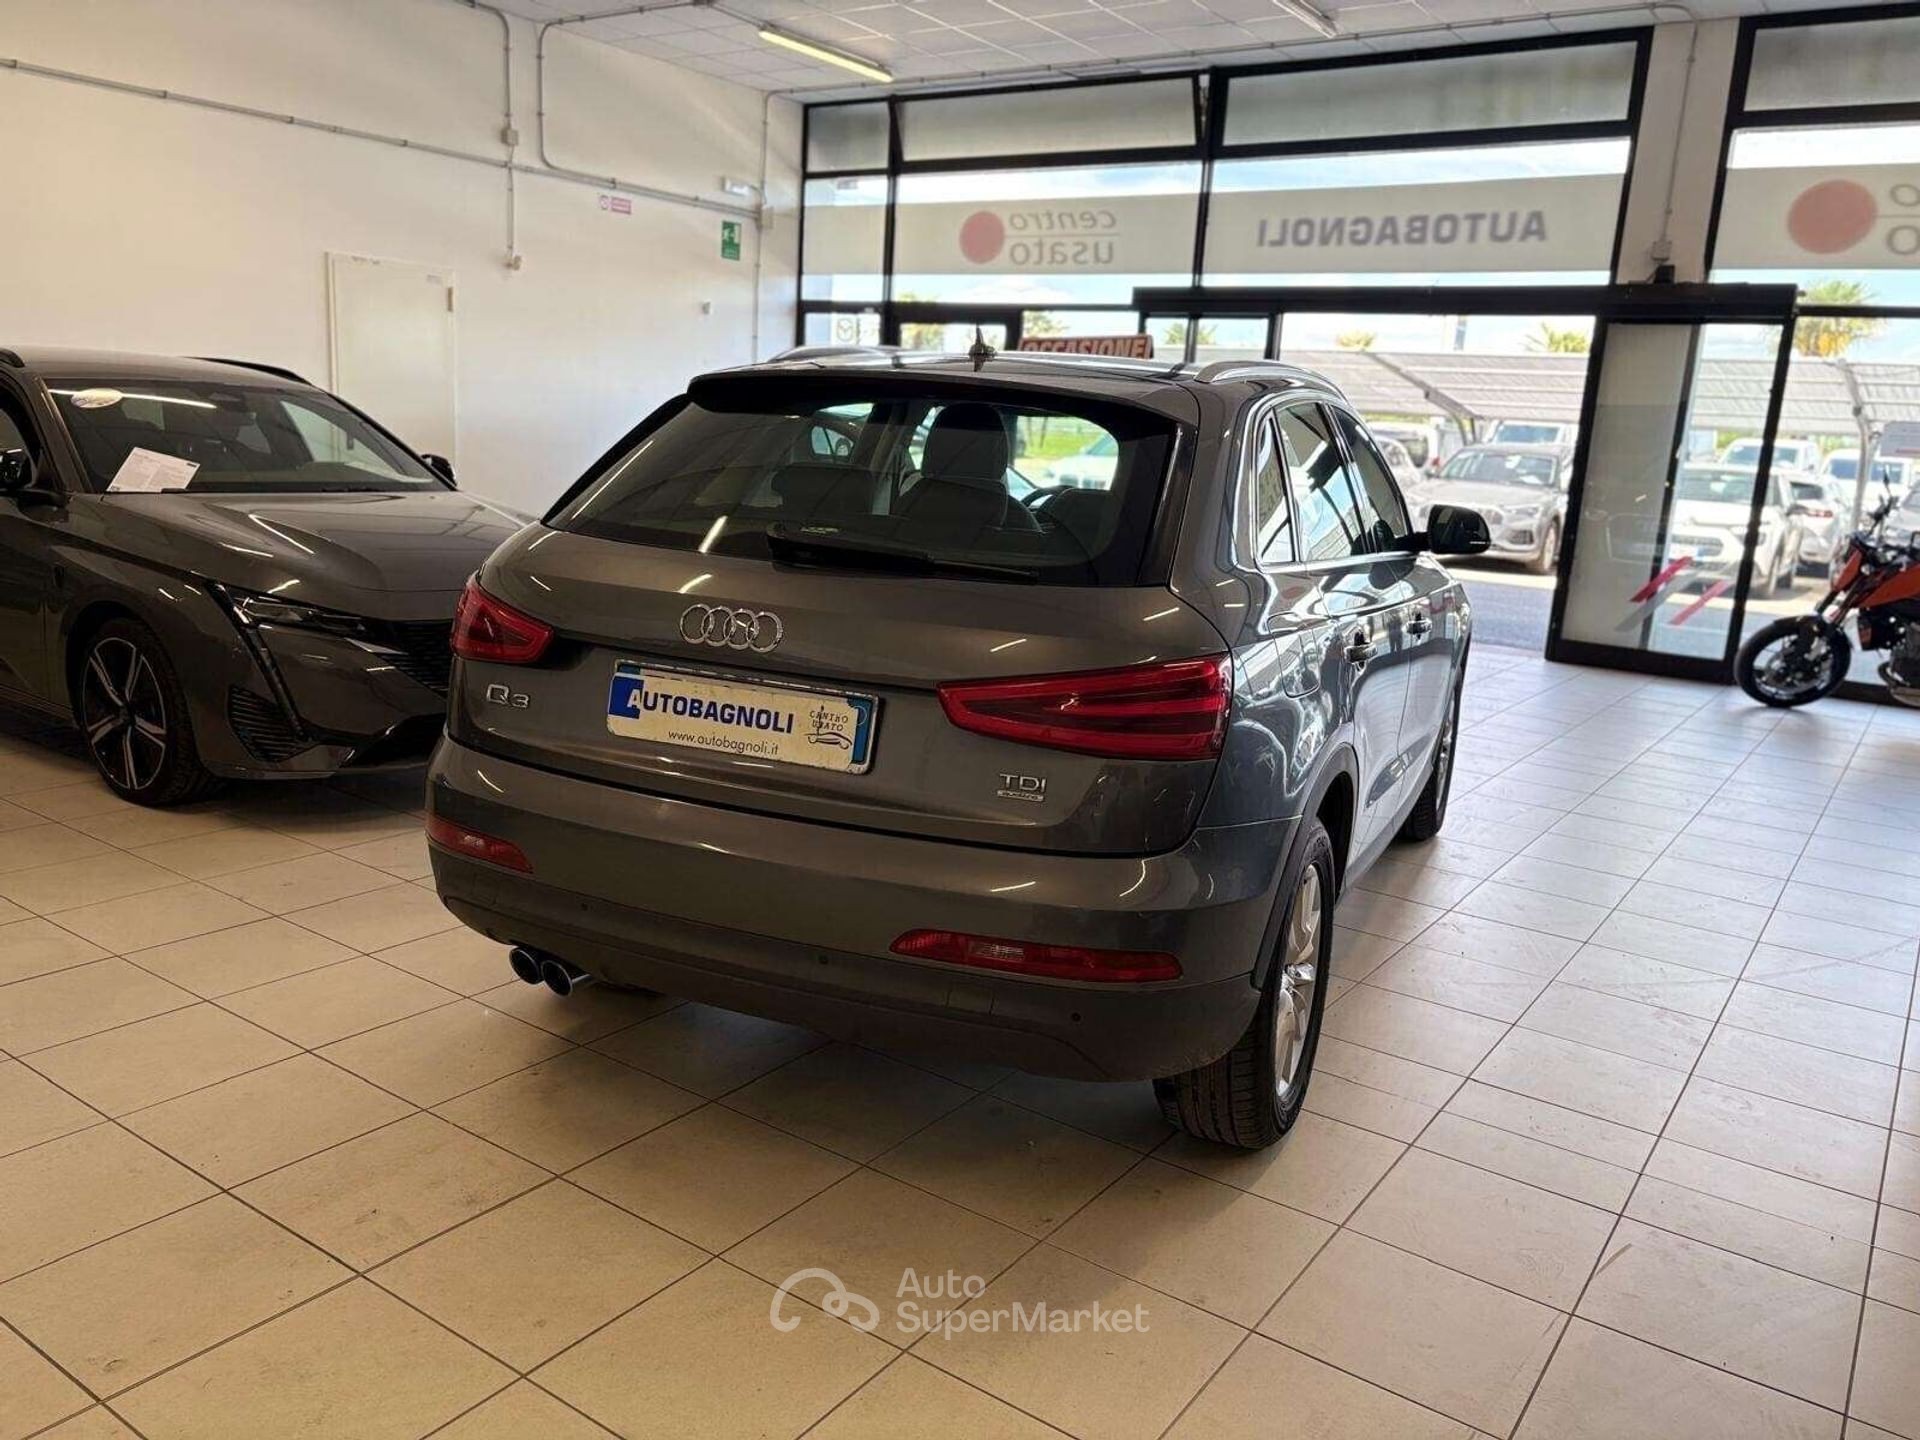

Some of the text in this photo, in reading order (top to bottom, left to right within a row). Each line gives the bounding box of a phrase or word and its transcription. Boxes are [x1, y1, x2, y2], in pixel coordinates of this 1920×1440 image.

[486, 683, 529, 708] Q3
[626, 688, 795, 734] AUTOBAGNOLI
[667, 729, 779, 756] www.autobagnoli.it
[999, 773, 1047, 793] TDI
